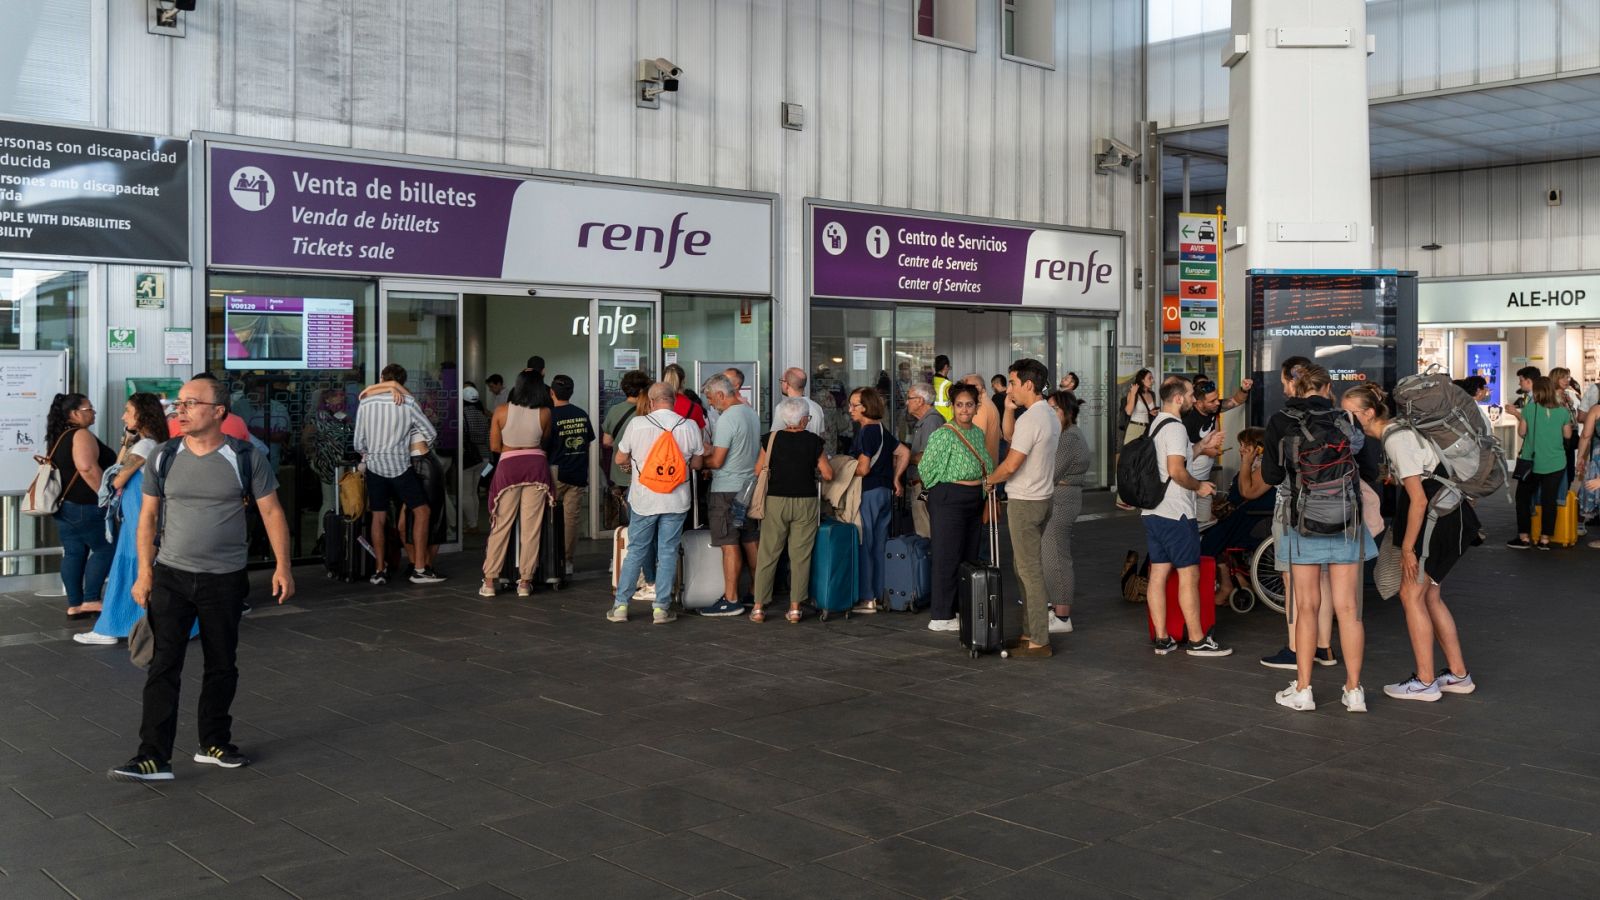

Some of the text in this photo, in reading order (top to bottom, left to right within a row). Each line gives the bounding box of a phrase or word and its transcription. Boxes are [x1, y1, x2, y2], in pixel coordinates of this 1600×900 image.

[0, 153, 51, 169] ducida
[56, 142, 82, 154] con
[87, 144, 177, 164] discapacidad
[0, 174, 160, 196] rsones amb discapacitat
[292, 171, 477, 208] Venta de billetes
[0, 211, 131, 230] PLE WITH DISABILITIES
[291, 206, 440, 233] Venda de bitllets
[291, 237, 395, 260] Tickets sale
[577, 212, 712, 270] renfe
[898, 228, 1007, 253] Centro de Servicios
[898, 254, 978, 272] Centre de Serveis
[1035, 250, 1112, 294] renfe
[1185, 266, 1211, 274] Europcar
[898, 276, 981, 294] Center of Services
[1507, 290, 1586, 308] ALE-HOP
[1190, 320, 1206, 331] OK
[1270, 329, 1326, 337] LEONARDO
[1341, 373, 1366, 381] NIRO
